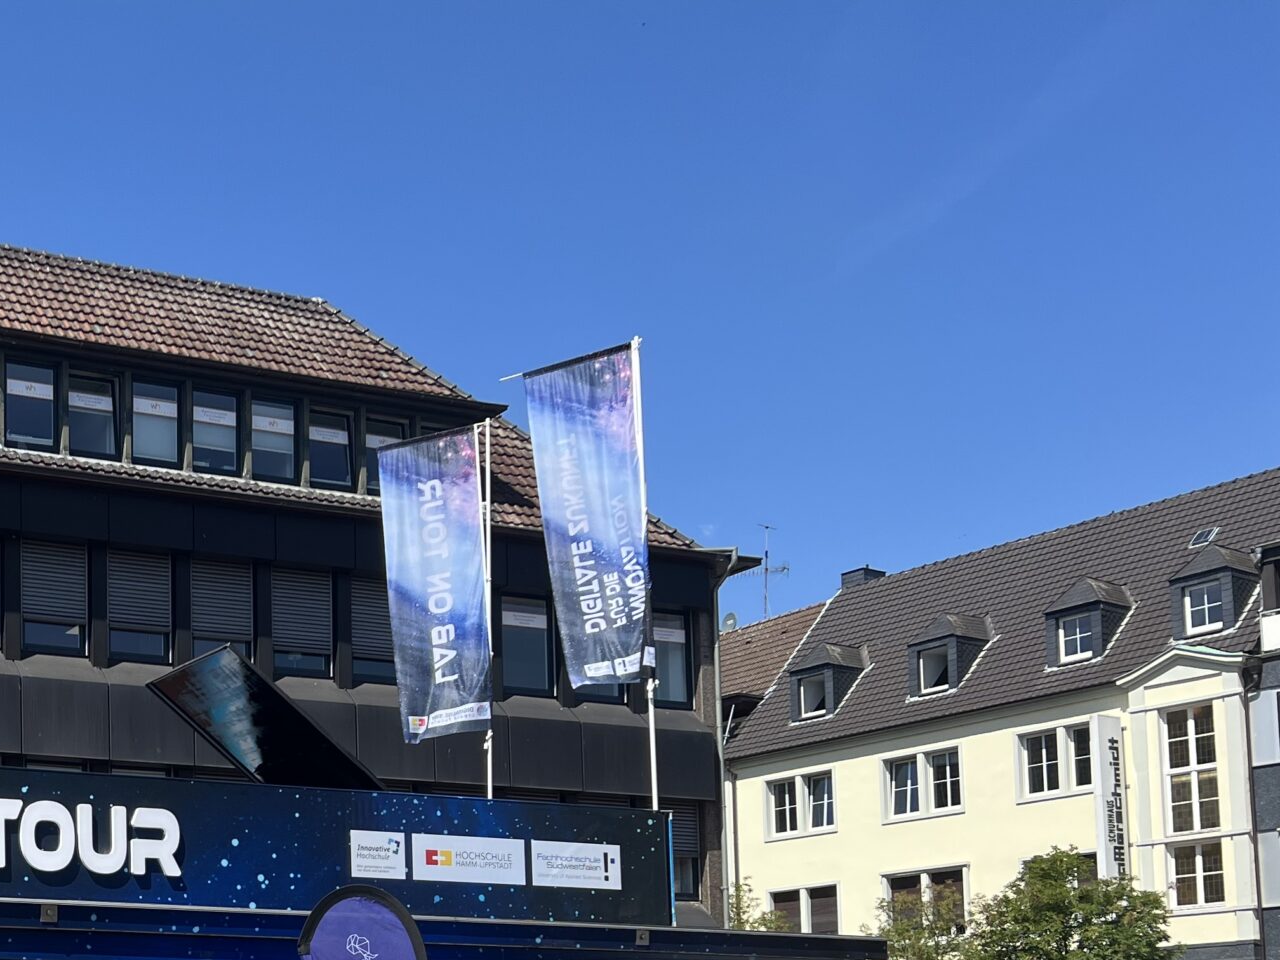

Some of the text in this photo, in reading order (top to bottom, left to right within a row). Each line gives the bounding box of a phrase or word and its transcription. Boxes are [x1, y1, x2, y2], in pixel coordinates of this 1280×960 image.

[1106, 799, 1117, 843] SCHUHHAUS
[357, 843, 391, 853] Innovative
[356, 852, 390, 860] Hochschule
[455, 850, 512, 862] HOCHSCHULE
[536, 852, 601, 864] Fachhochschule
[455, 860, 512, 870] HAMM-LIPPSTADT
[546, 861, 601, 871] Südwestfalen
